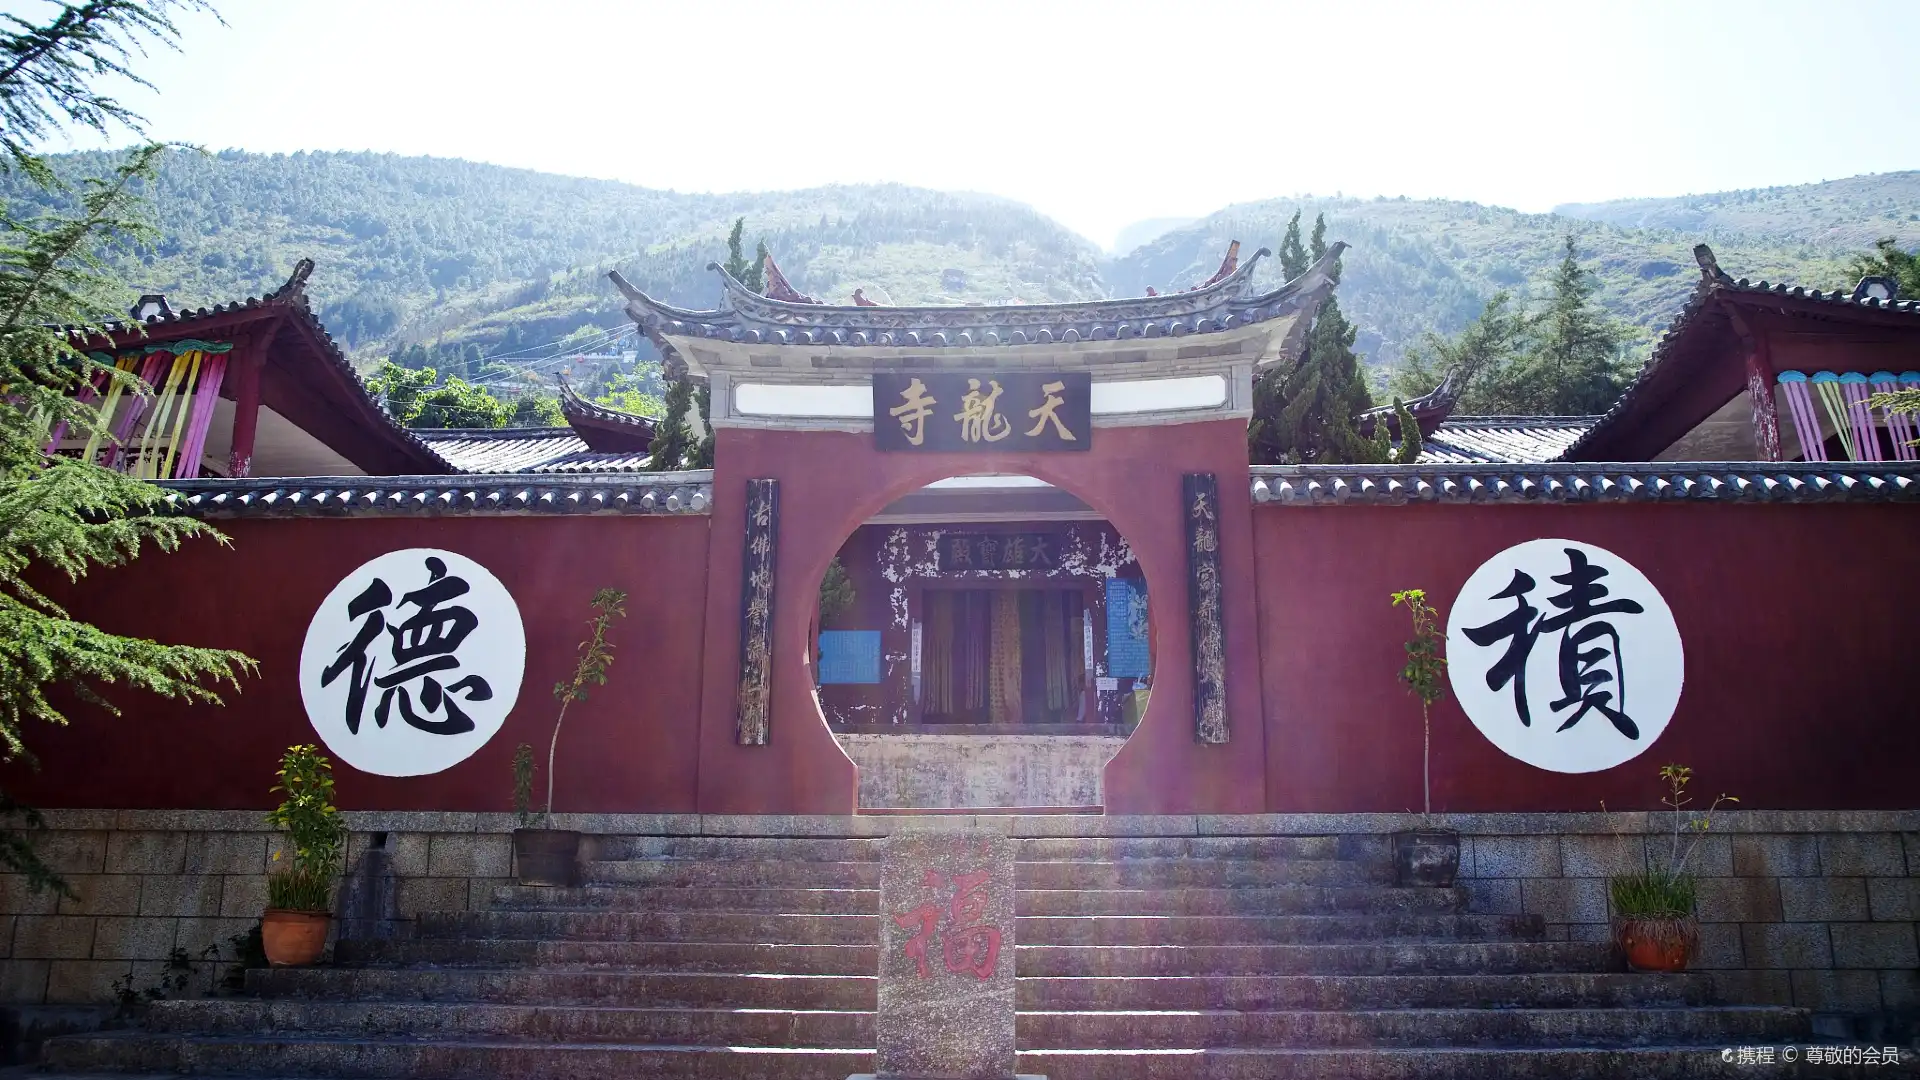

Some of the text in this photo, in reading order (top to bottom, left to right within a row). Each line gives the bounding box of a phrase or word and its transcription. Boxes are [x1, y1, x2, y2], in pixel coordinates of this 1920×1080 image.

[889, 377, 1077, 446] 天龍寺
[950, 536, 1052, 567] 大雄寶殿
[321, 556, 493, 735] 德
[1461, 548, 1644, 740] 積
[893, 869, 1001, 982] 福
